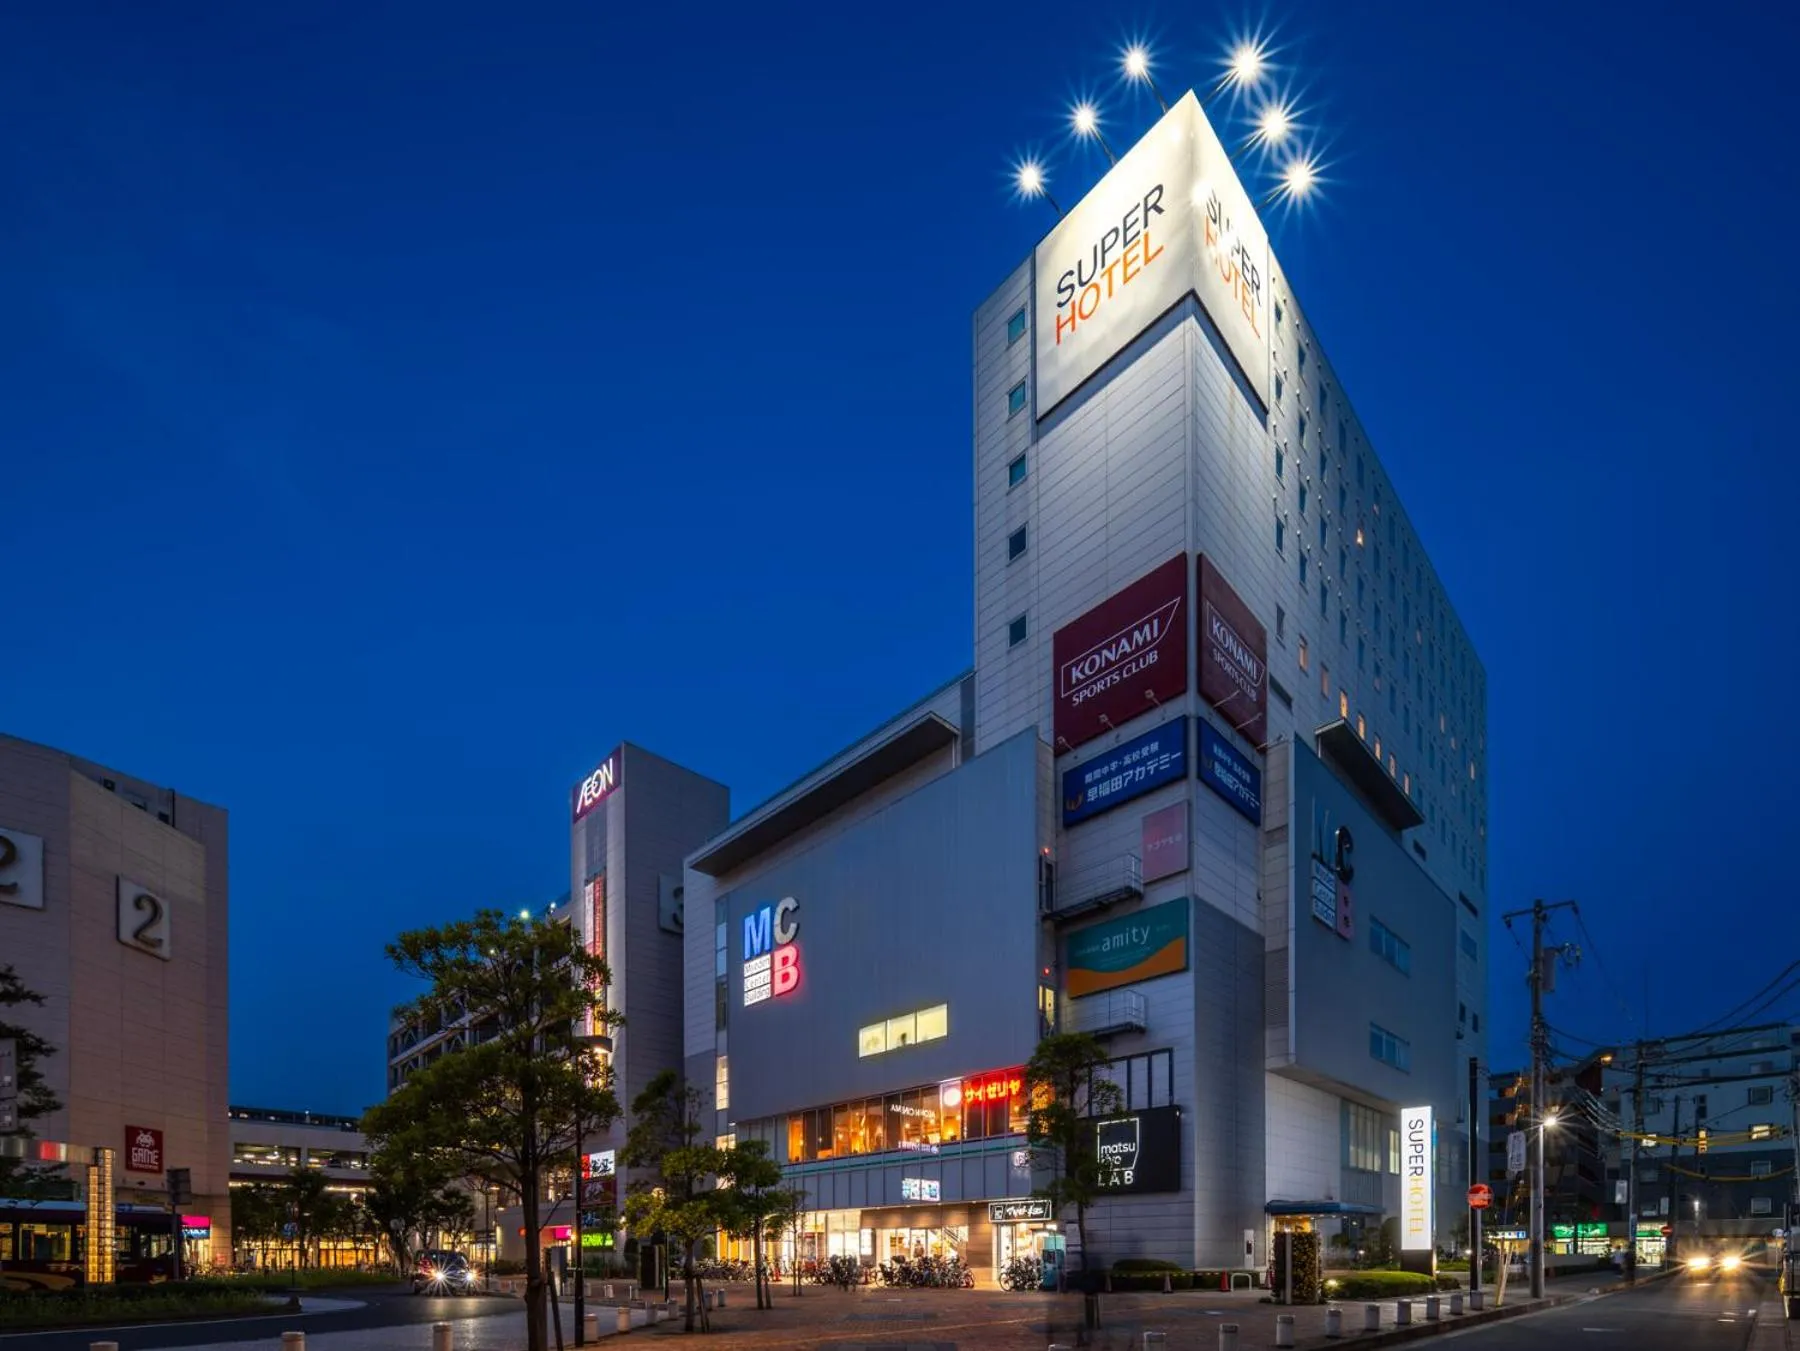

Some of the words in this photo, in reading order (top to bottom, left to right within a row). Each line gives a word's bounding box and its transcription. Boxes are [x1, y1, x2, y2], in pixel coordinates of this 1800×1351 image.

[1056, 184, 1165, 308] SUPER
[1056, 231, 1165, 345] HOTEL
[1071, 618, 1159, 685] KONAMI
[1212, 615, 1258, 680] KONAMI
[1072, 670, 1120, 706] SPORTS
[1122, 650, 1159, 678] CLUB
[1086, 751, 1183, 803] 早稲田アカデミー
[133, 894, 164, 948] 2
[1101, 925, 1151, 953] amity
[964, 1079, 1021, 1103] サイゼリヤ
[131, 1146, 161, 1165] GAME
[1100, 1142, 1136, 1155] matsu
[1407, 1118, 1424, 1176] SUPER
[1407, 1176, 1424, 1237] HOTEL
